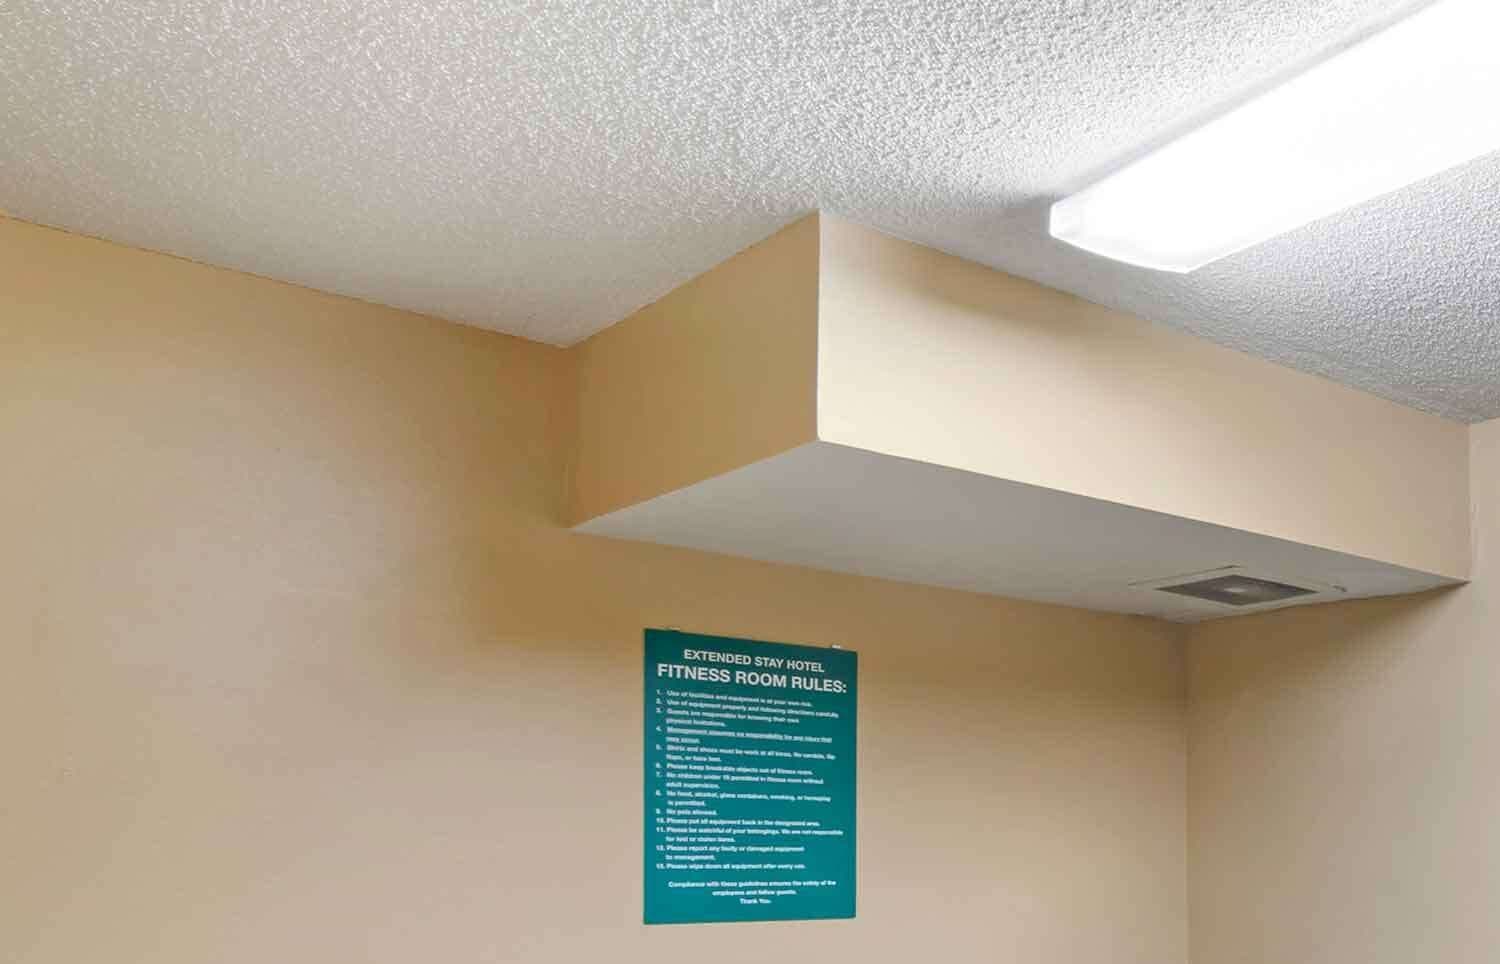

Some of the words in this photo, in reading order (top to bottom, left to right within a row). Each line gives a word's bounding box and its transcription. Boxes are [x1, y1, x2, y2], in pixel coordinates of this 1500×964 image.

[684, 649, 751, 665] EXTENDED
[754, 656, 784, 669] STAY
[786, 660, 825, 673] HOTEL
[657, 663, 731, 683] FITNESS
[735, 672, 787, 688] ROOM
[791, 676, 848, 693] RULES:
